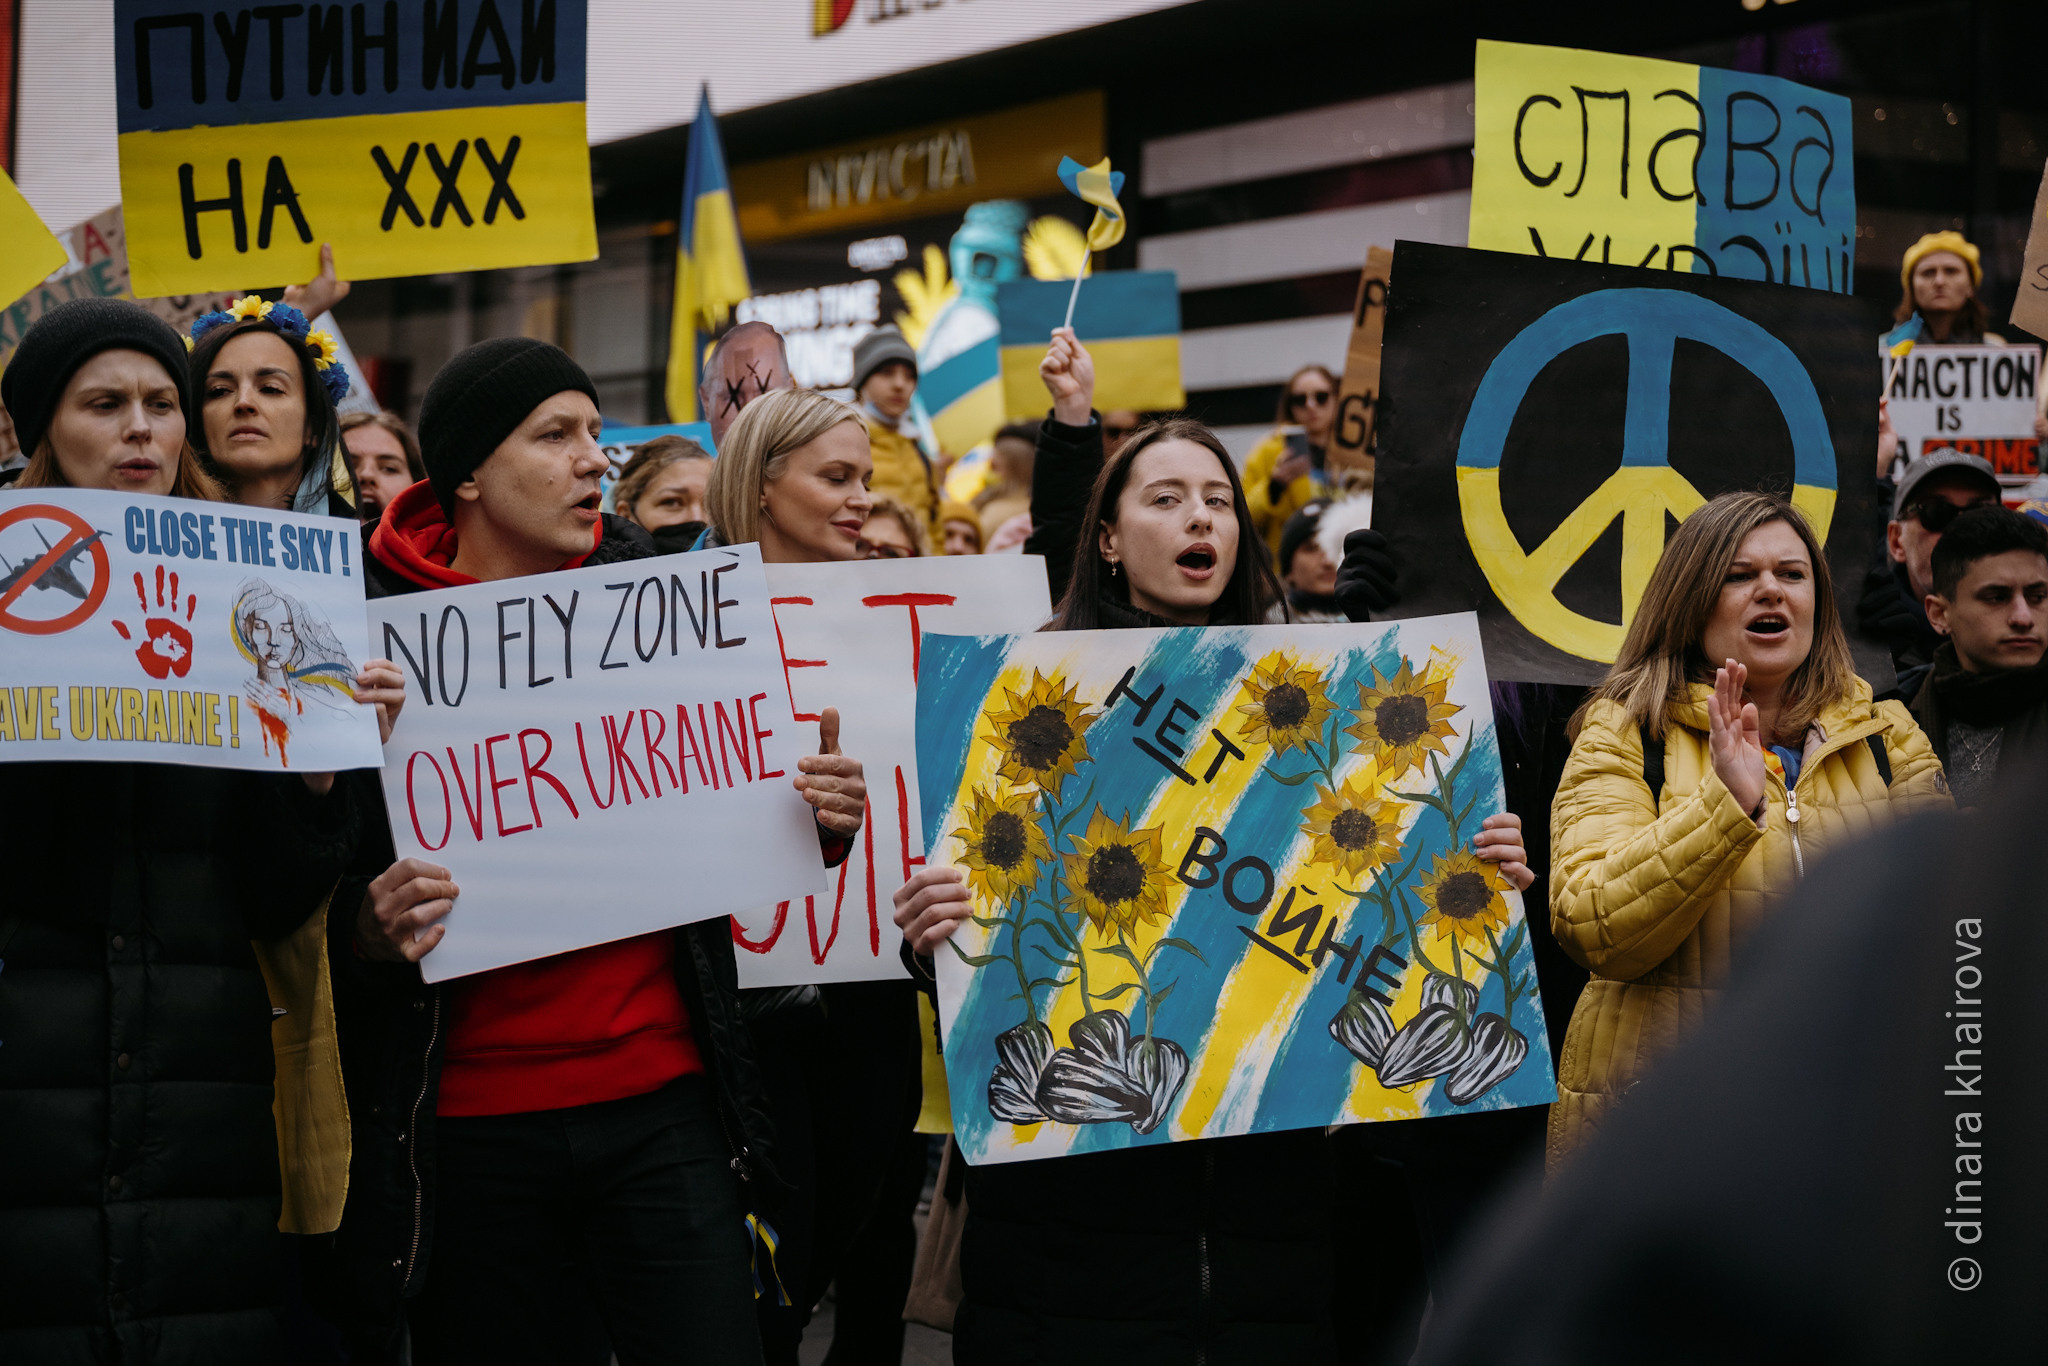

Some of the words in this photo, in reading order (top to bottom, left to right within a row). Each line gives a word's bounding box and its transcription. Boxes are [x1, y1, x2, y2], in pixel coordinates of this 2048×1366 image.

[134, 3, 398, 109] ПУТИН
[422, 0, 556, 90] ИДИ
[178, 155, 314, 259] НА
[1937, 406, 1961, 431] IS
[125, 506, 217, 562] CLOSE
[220, 516, 276, 567] THE
[279, 524, 333, 576] SKY
[383, 604, 469, 708] NO
[496, 590, 579, 689] FLY
[599, 562, 747, 670] ZONE
[0, 686, 61, 742] AVE
[69, 686, 223, 747] UKRAINE
[1103, 665, 1246, 784] НЕТ
[406, 728, 579, 851] OVER
[575, 692, 786, 810] UKRAINE
[1177, 826, 1409, 1007] ВОЙНЕ
